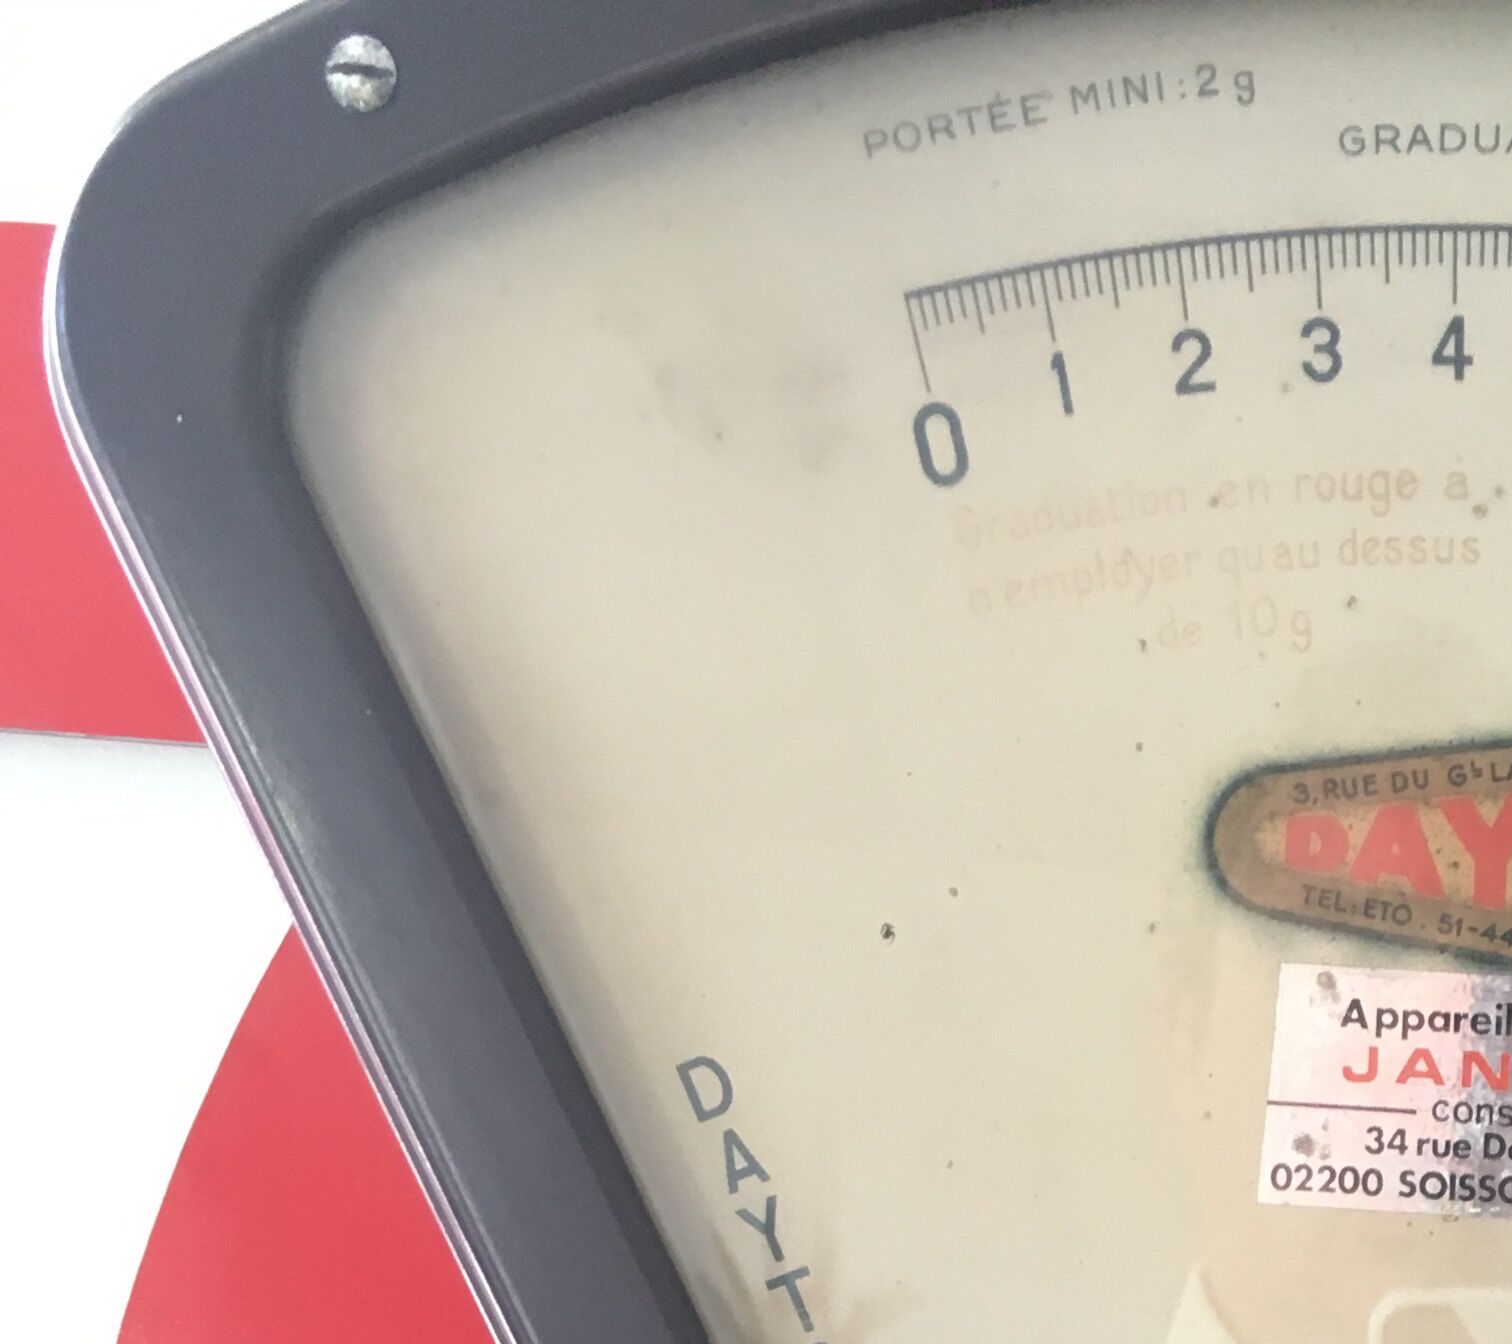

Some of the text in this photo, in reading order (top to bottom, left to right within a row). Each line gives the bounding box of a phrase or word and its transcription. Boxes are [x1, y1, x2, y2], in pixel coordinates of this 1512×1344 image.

[863, 91, 1050, 158] PORTÉE
[912, 401, 970, 487] 0
[1050, 350, 1075, 415] 1
[1171, 328, 1217, 395] 2
[1300, 316, 1343, 383] 3
[1431, 315, 1474, 381] 4
[1218, 472, 1271, 508] en
[1294, 468, 1419, 518] rouge
[1337, 527, 1481, 568] dessus
[1391, 768, 1430, 794] DU
[1364, 1125, 1408, 1156] 34
[1417, 1132, 1473, 1161] rue
[1270, 1162, 1384, 1198] 02200
